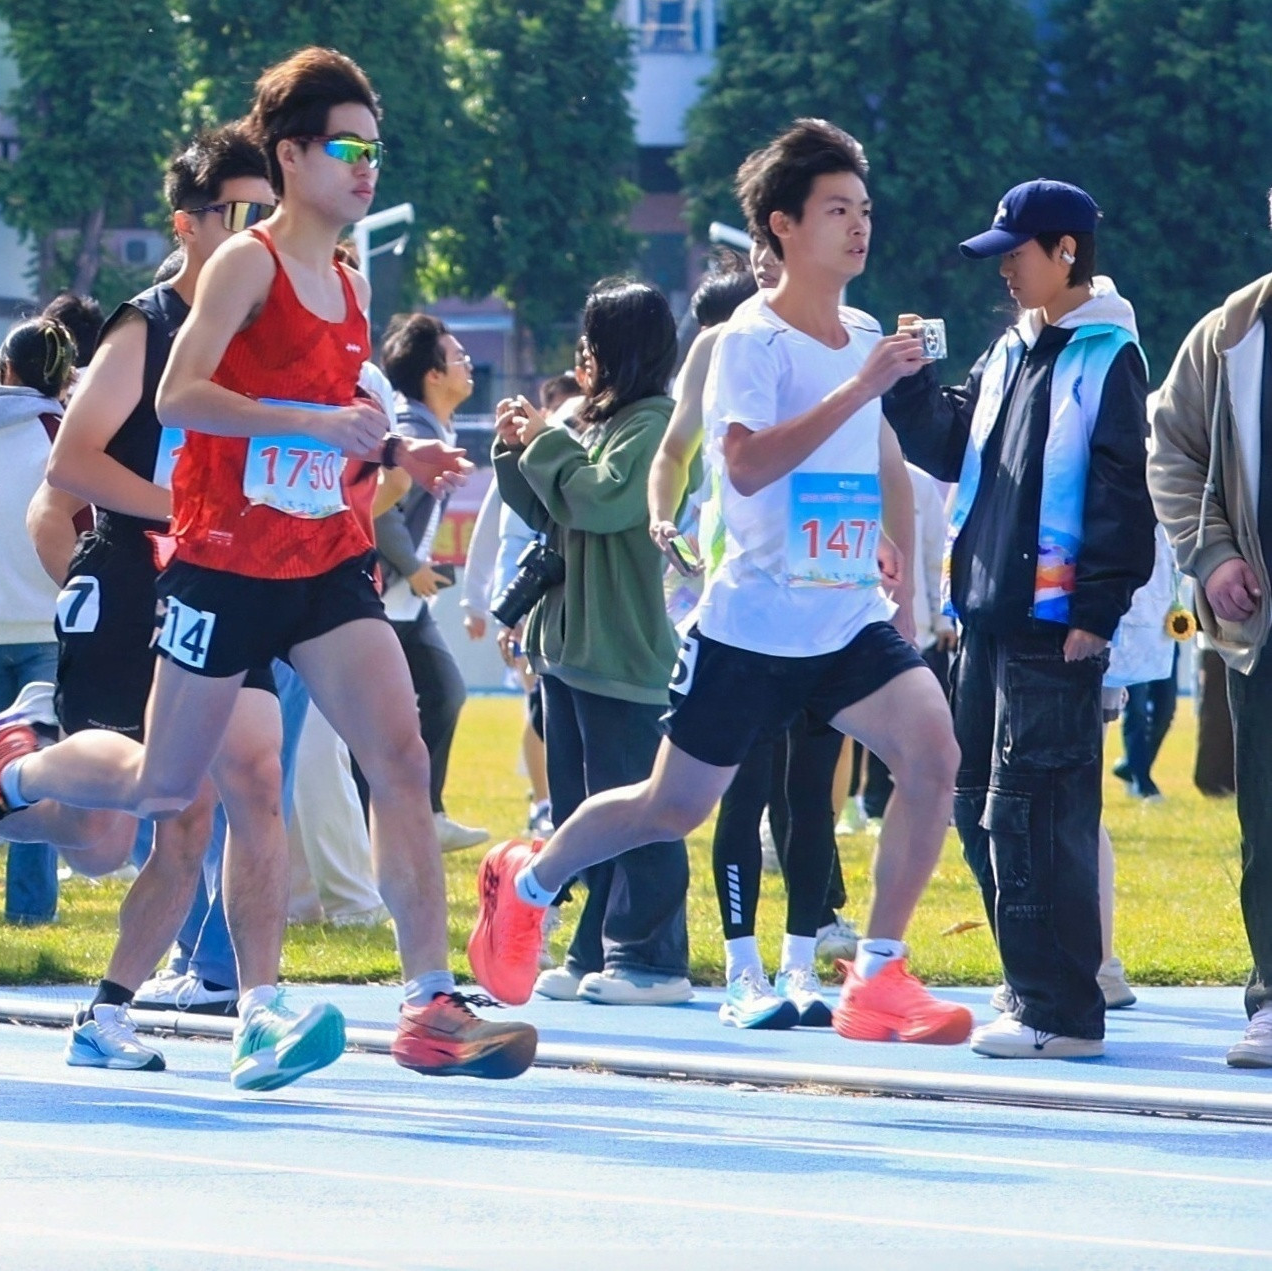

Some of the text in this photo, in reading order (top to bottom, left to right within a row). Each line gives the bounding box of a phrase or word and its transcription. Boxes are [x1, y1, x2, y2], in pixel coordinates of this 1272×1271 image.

[261, 447, 334, 490] 1750
[65, 583, 94, 628] 7
[169, 606, 207, 662] 14
